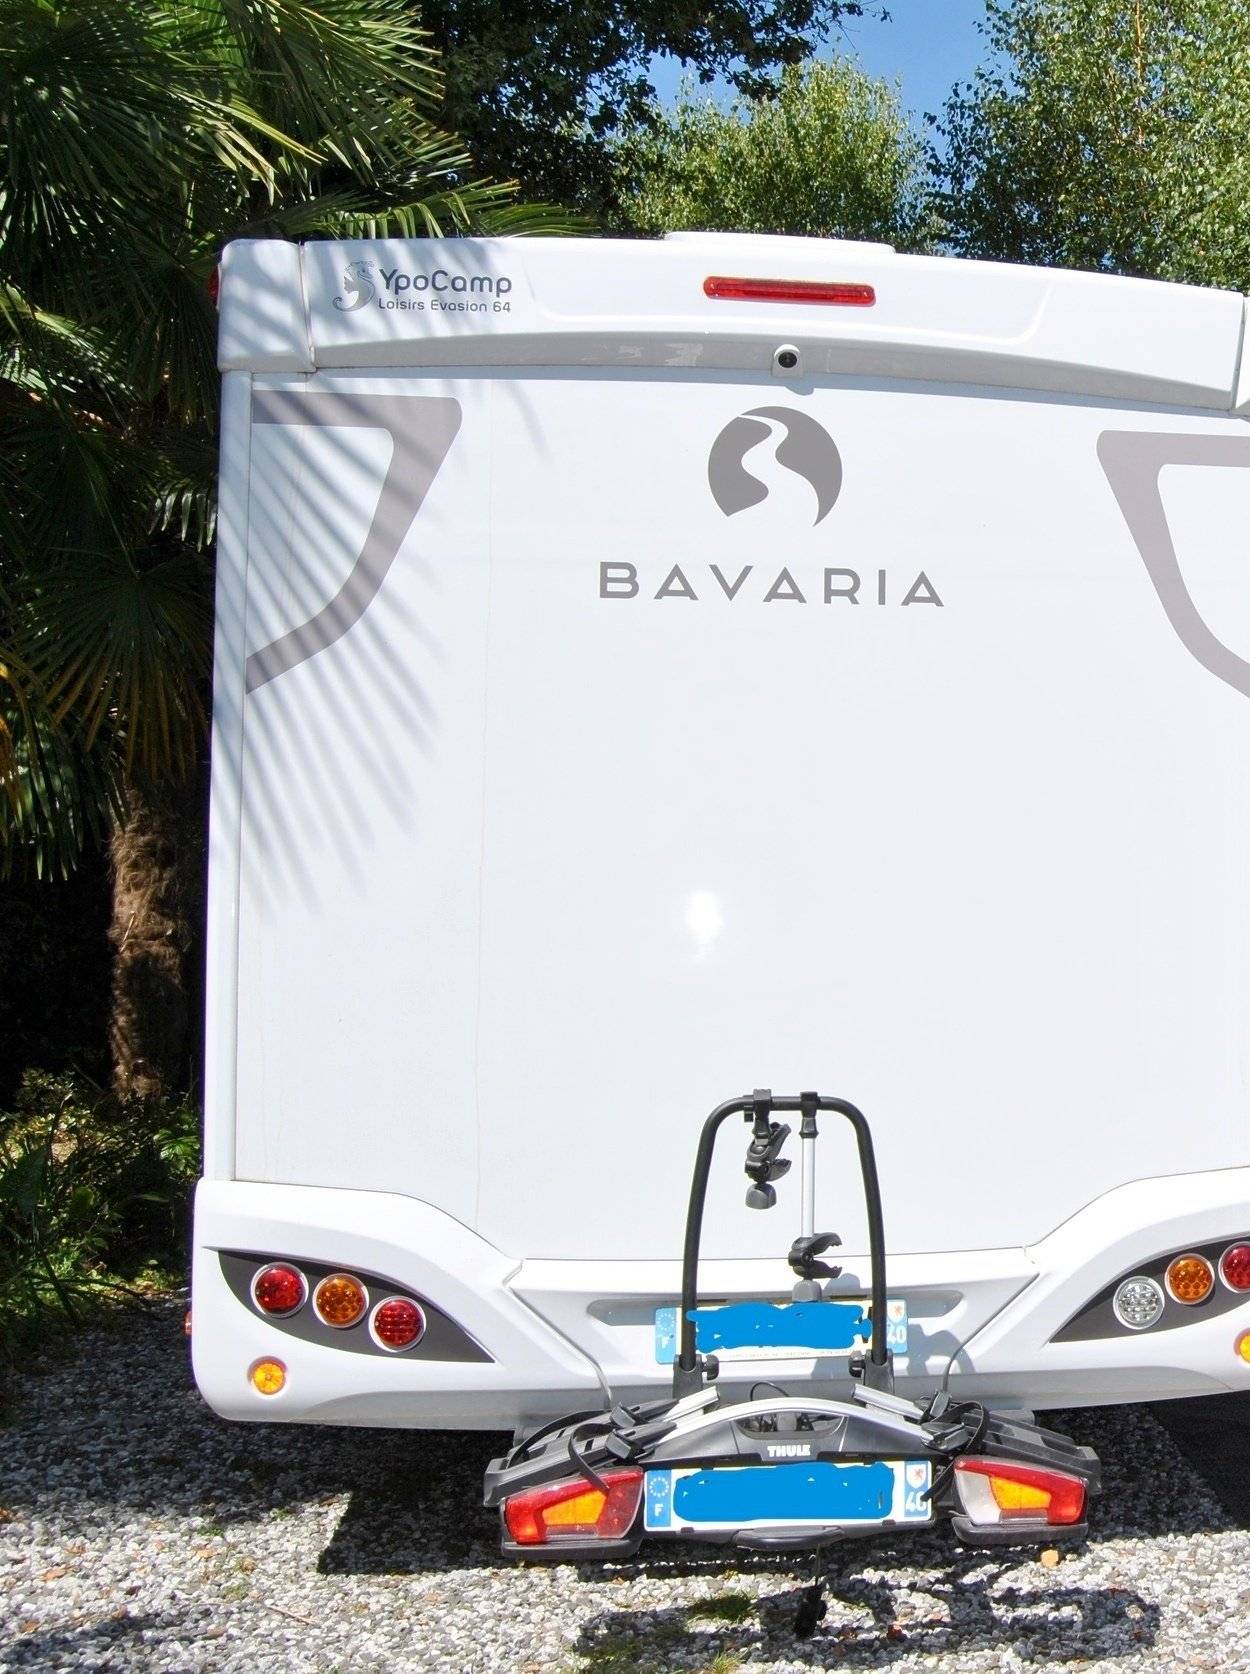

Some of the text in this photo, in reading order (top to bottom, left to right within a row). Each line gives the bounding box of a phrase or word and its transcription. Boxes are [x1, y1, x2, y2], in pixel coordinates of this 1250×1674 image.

[379, 268, 512, 297] YpoCamp
[379, 298, 511, 313] Loisirs Evasion 64
[599, 561, 945, 607] BAVARIA
[660, 1336, 670, 1349] F
[767, 1444, 811, 1458] THULE
[654, 1503, 664, 1517] F
